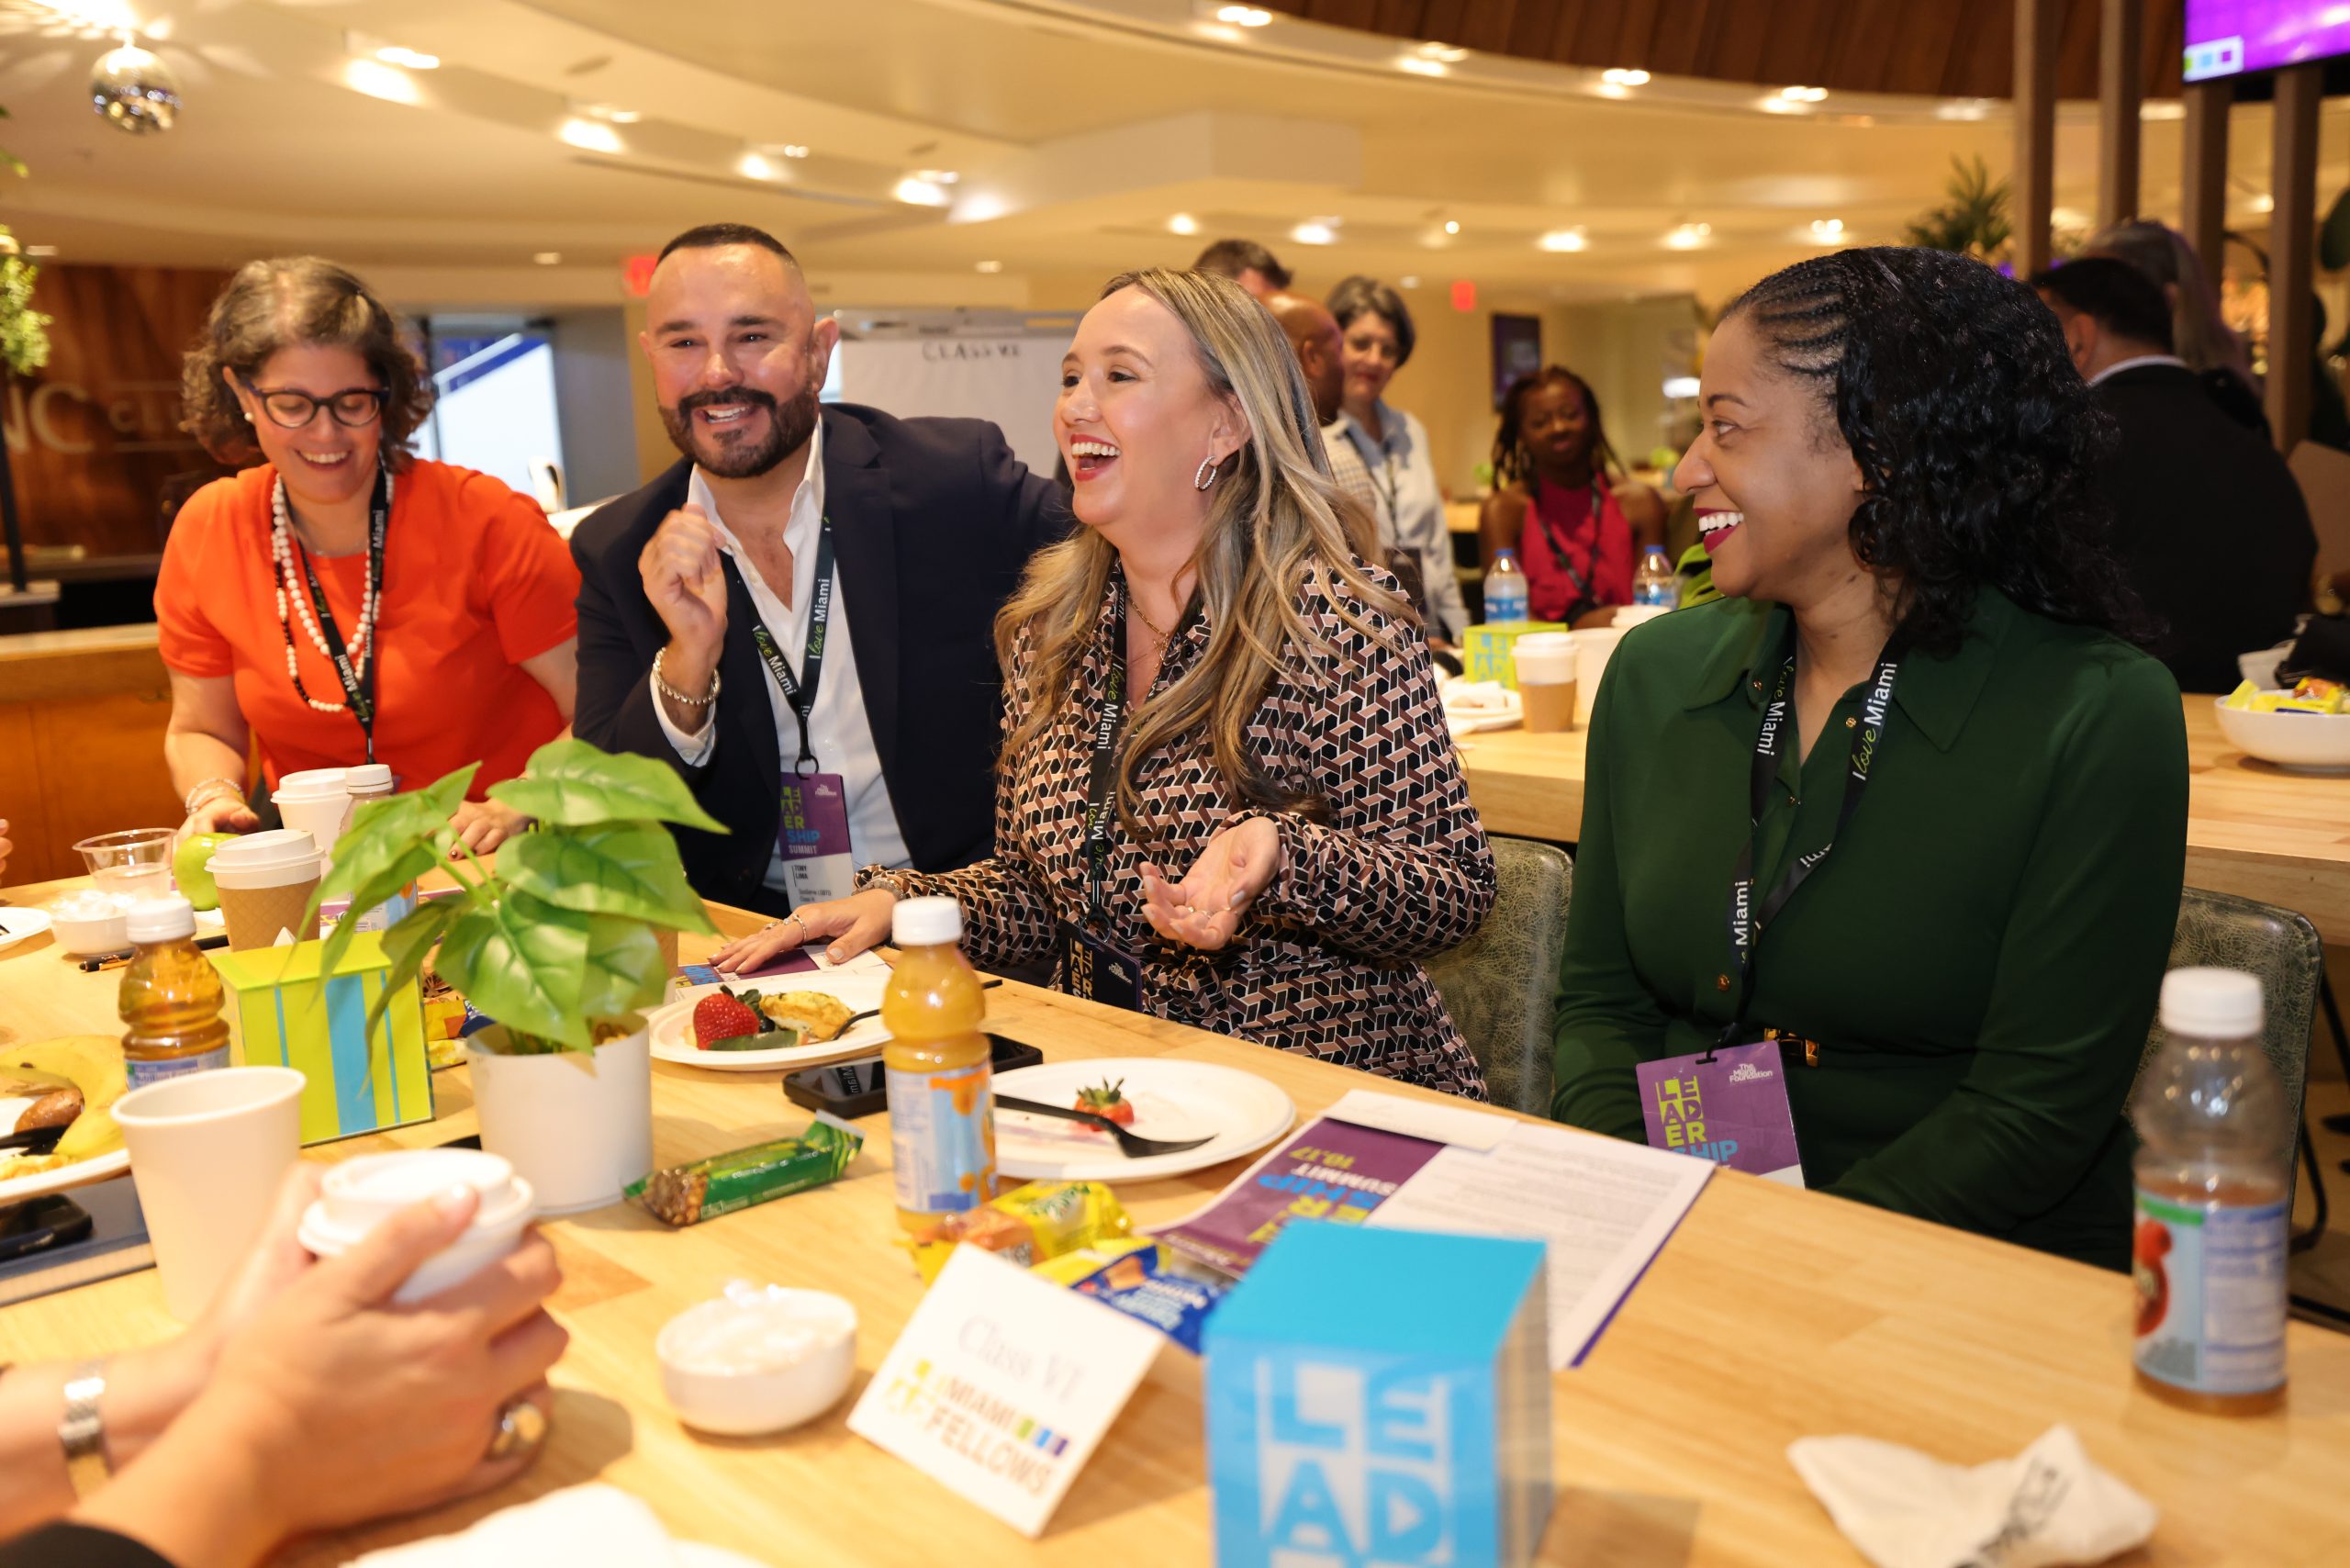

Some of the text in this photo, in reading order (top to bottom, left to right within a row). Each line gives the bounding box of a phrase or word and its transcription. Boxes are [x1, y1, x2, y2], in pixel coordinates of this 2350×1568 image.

[372, 510, 384, 548] Miami
[814, 578, 830, 622] Miami
[808, 624, 824, 655] love
[334, 655, 358, 692] Miami
[754, 631, 772, 656] love
[768, 655, 797, 695] Miami
[1107, 670, 1126, 700] love
[1863, 663, 1897, 726] Miami
[1097, 703, 1118, 750] Miami
[1757, 701, 1785, 756] Miami
[1852, 728, 1876, 773] love
[784, 815, 805, 830] ER
[1091, 791, 1115, 840] Miami
[786, 829, 821, 843] SHIP
[789, 843, 818, 855] SUMMIT
[1733, 880, 1749, 946] Miami
[1655, 1076, 1700, 1103] LE
[1660, 1098, 1704, 1125] AD
[1665, 1121, 1707, 1147] ER
[1258, 1174, 1385, 1210] SHIP
[1290, 1162, 1399, 1196] SUMMIT
[958, 1314, 1035, 1383] Class
[944, 1375, 1018, 1430] MIAMI
[923, 1404, 1054, 1497] FELLOWS
